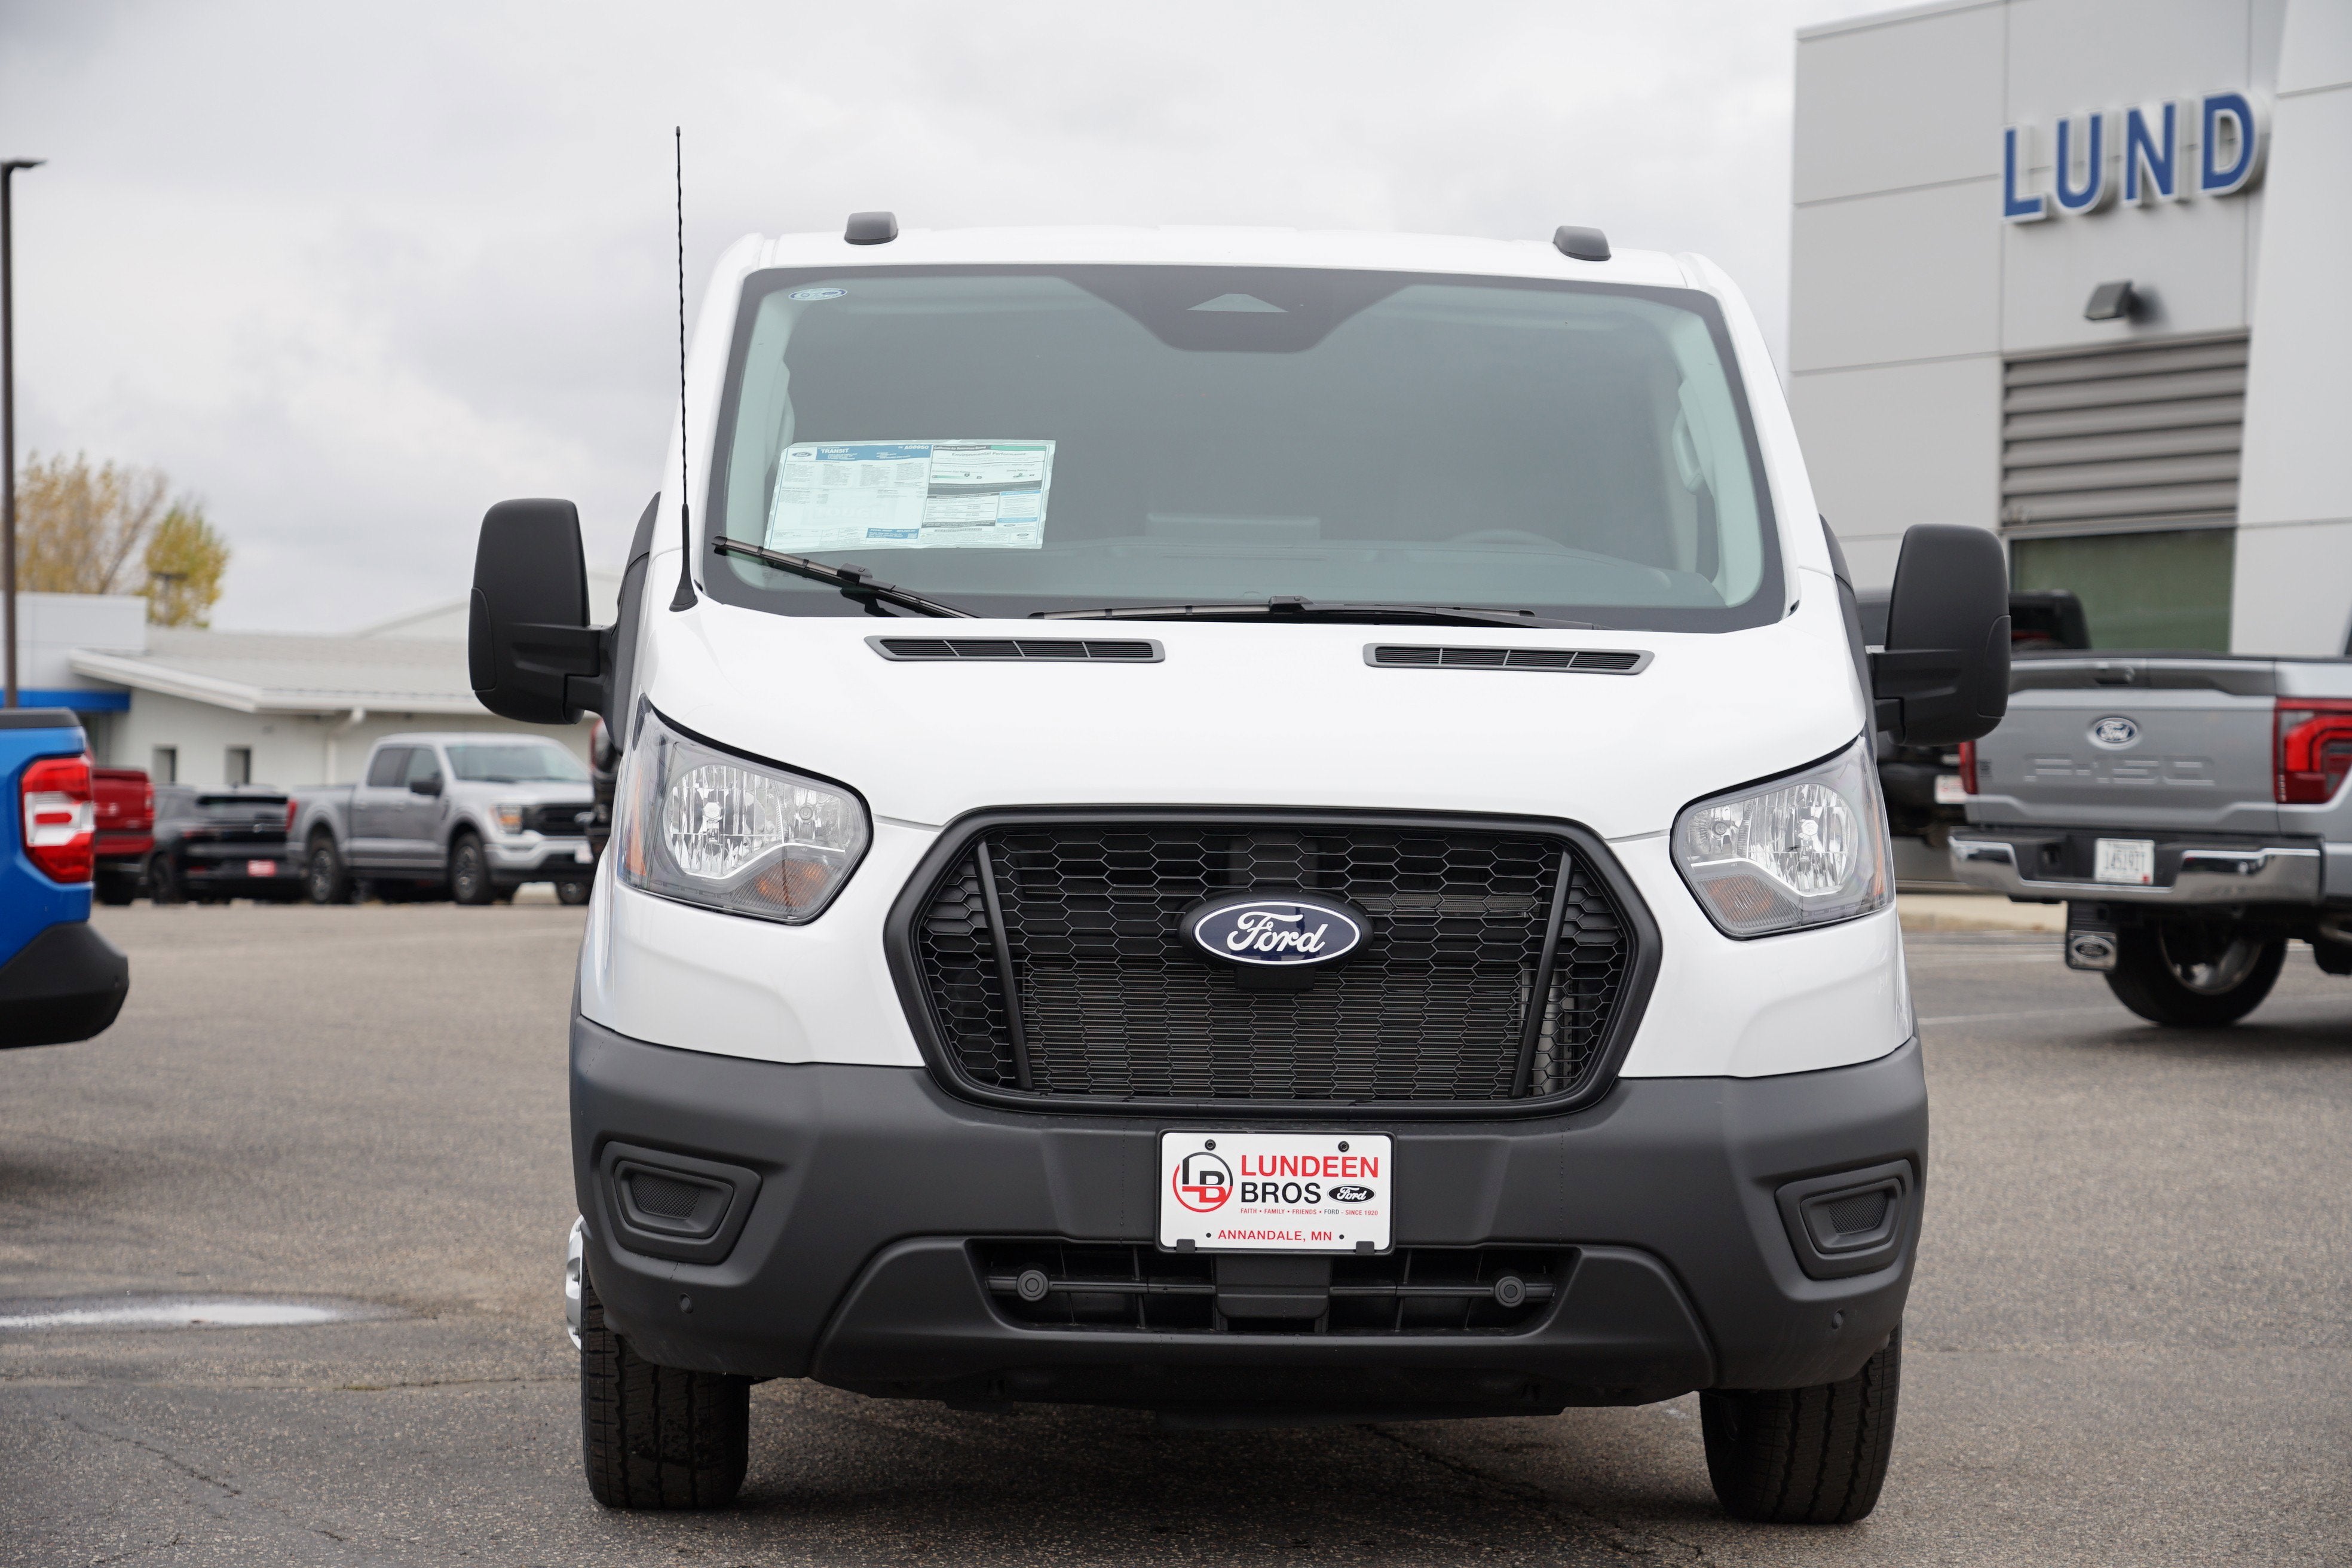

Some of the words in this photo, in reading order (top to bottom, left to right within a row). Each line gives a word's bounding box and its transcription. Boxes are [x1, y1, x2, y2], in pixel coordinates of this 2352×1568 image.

[2002, 90, 2260, 220] LUND
[1226, 911, 1328, 953] Ford
[1241, 1154, 1379, 1178] LUNDEEN
[1240, 1181, 1321, 1204] BROS
[1336, 1185, 1367, 1201] Ford
[1217, 1229, 1307, 1243] ANNANDALE,
[1310, 1231, 1333, 1241] MN
